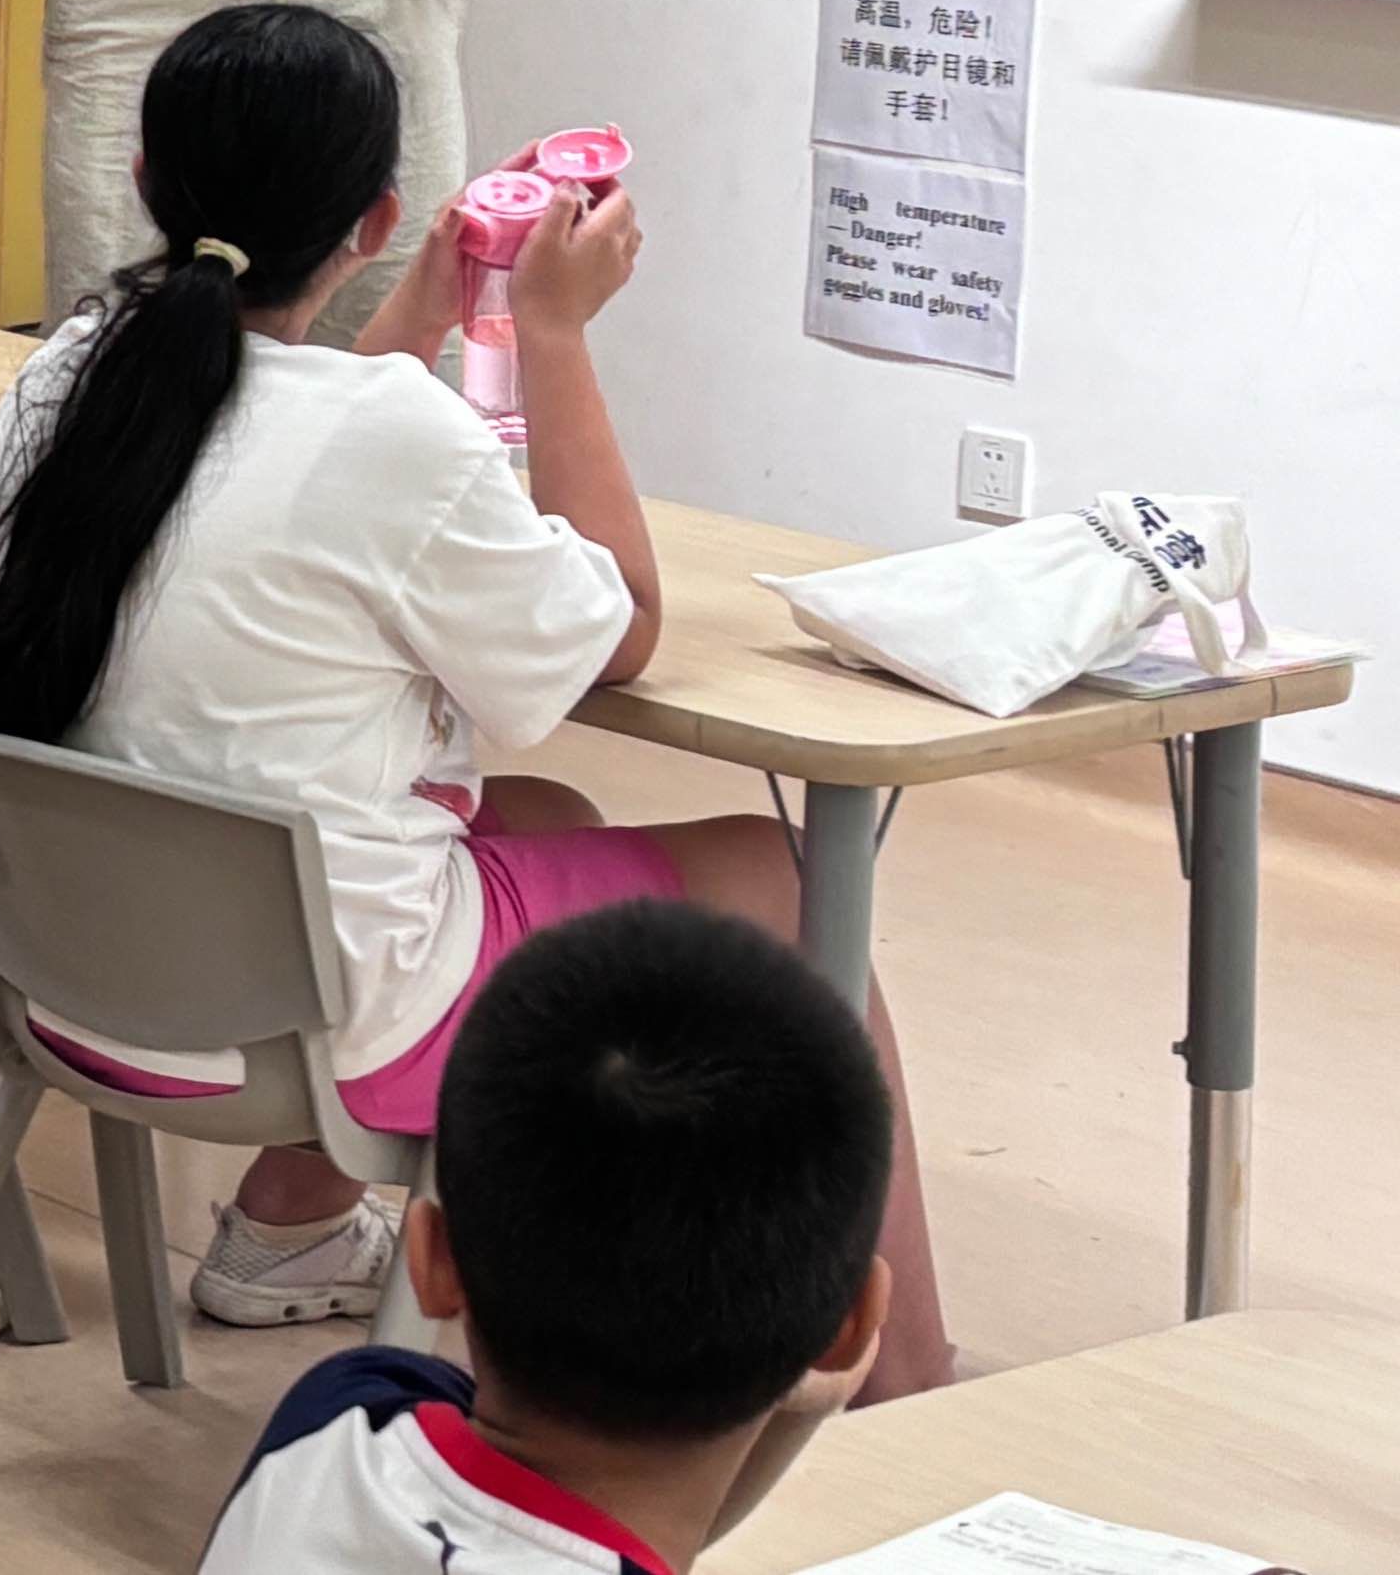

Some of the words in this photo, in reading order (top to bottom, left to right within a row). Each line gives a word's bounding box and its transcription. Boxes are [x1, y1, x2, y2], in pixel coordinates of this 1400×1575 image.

[840, 37, 1016, 88] 请佩戴护目镜和
[829, 186, 869, 215] High
[896, 201, 1007, 237] temperature
[851, 220, 922, 250] Danger!
[826, 243, 878, 272] Please
[892, 262, 938, 283] wear
[951, 268, 1004, 299] safety
[823, 275, 884, 303] goggles
[889, 285, 924, 310] and
[928, 291, 990, 323] gloves!
